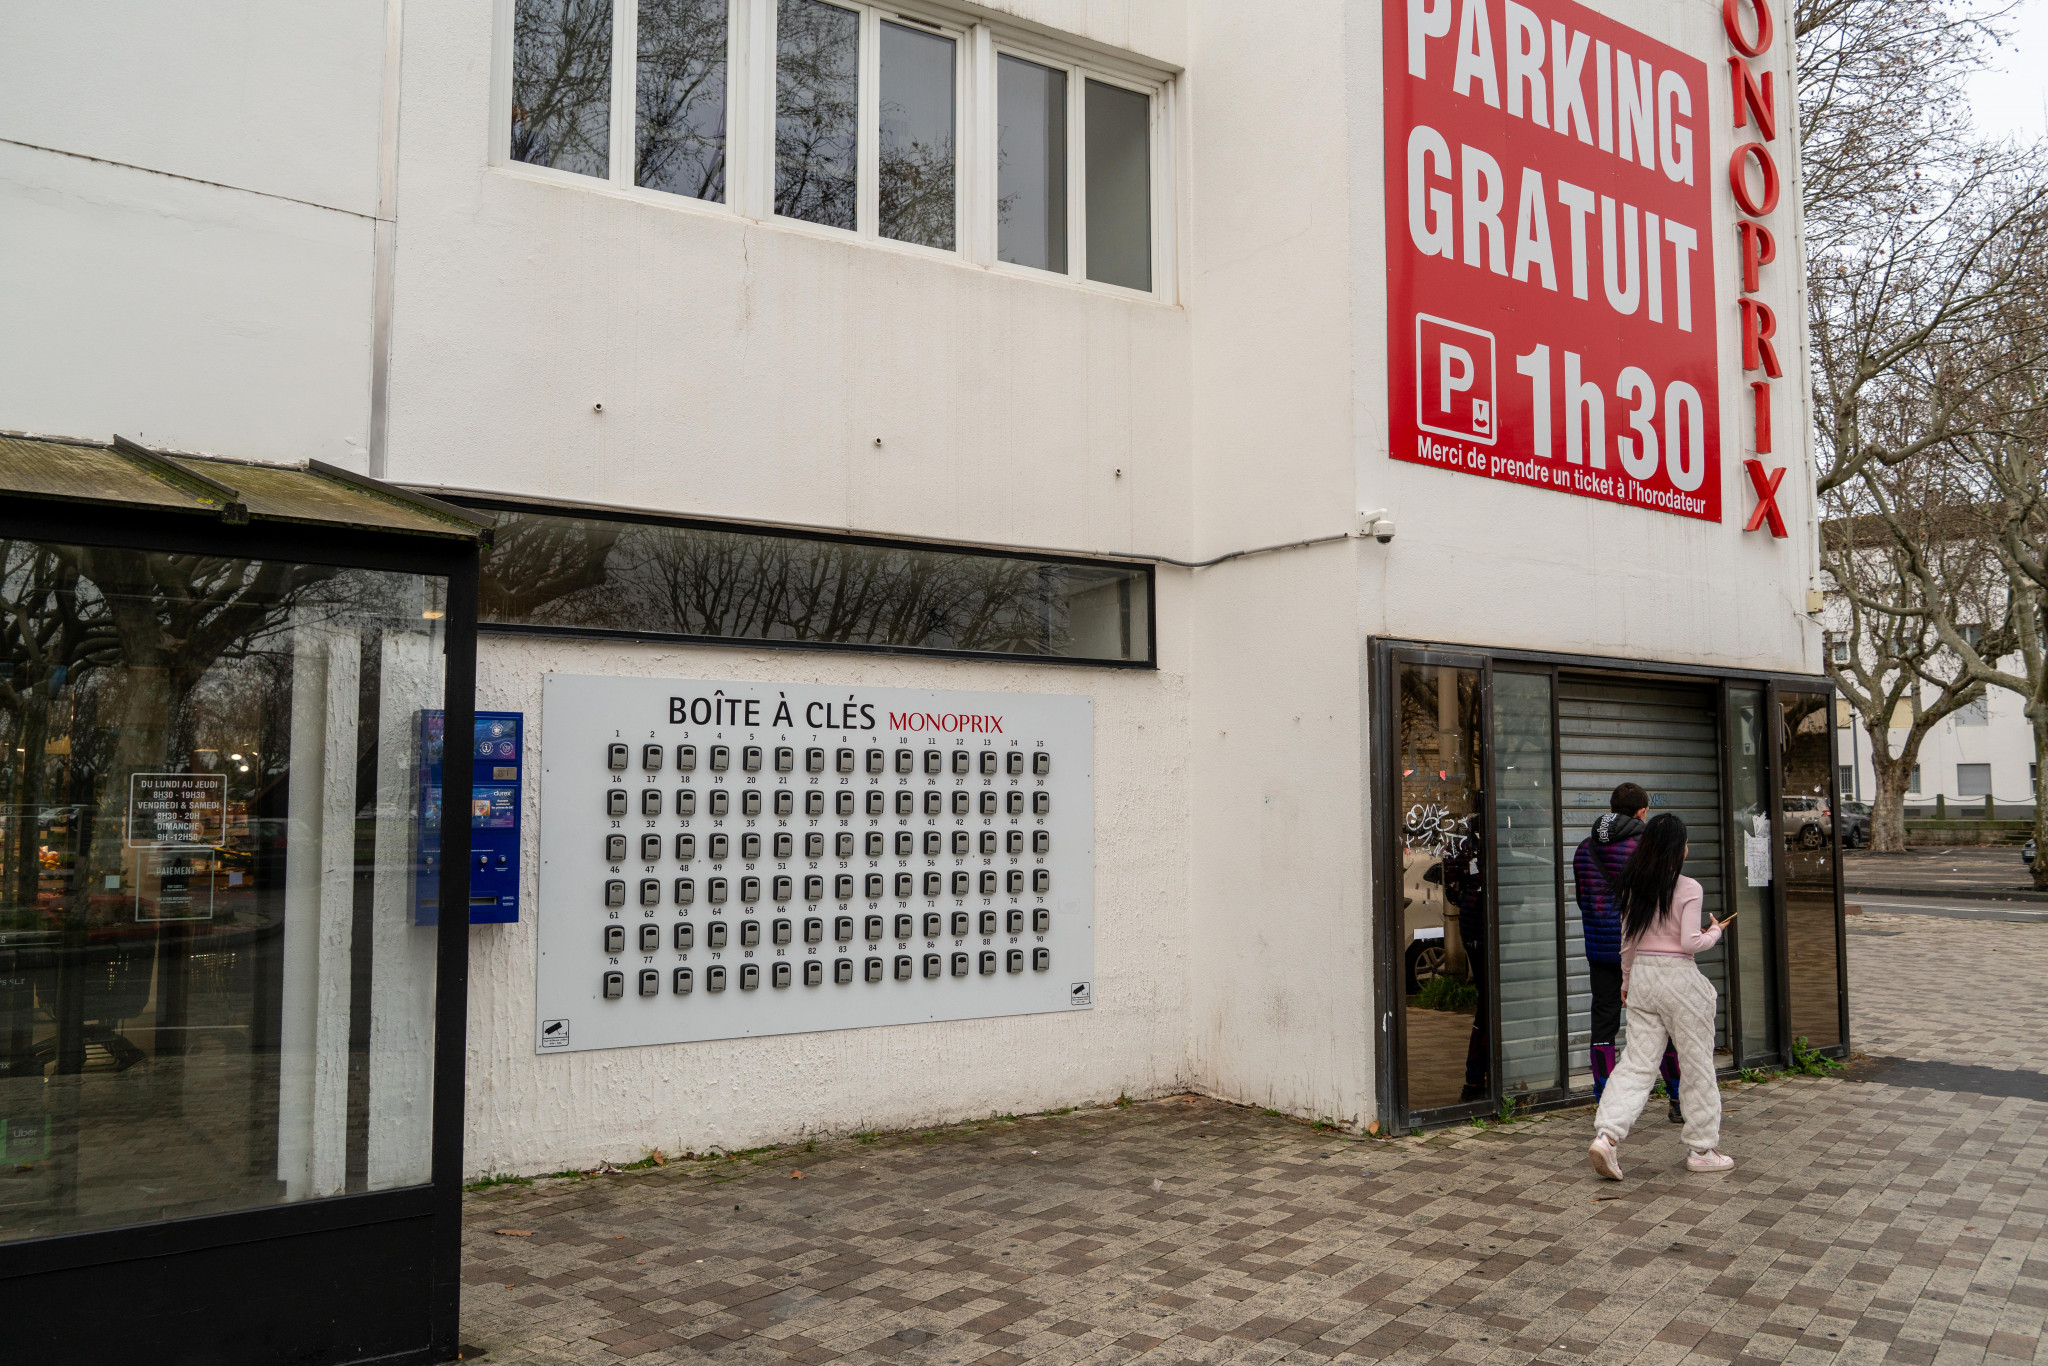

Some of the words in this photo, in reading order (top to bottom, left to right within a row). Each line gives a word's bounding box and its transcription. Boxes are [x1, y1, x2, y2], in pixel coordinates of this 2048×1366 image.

[1407, 0, 1694, 186] PARKING
[1407, 125, 1697, 332] GRATUIT
[1440, 342, 1475, 413] P
[1418, 435, 1462, 466] Merci
[1467, 446, 1486, 470] de
[1491, 455, 1549, 483] prendre
[1553, 468, 1570, 487] un
[1573, 469, 1614, 496] ticket
[1617, 477, 1625, 498] à
[1628, 480, 1706, 514] l'horodateur
[668, 690, 760, 725] BOÎTE
[772, 691, 794, 728] À
[806, 694, 876, 730] CLÉS
[889, 712, 1003, 734] MONOPRIX
[899, 736, 908, 744] 10
[928, 737, 936, 745] 11
[956, 738, 964, 746] 12
[983, 738, 992, 746] 13
[1010, 739, 1018, 747] 14
[1036, 740, 1044, 748] 15
[141, 780, 153, 788] DU
[155, 780, 180, 788] LUNDI
[182, 780, 193, 788] AU
[195, 780, 218, 788] JEUDI
[612, 775, 622, 783] 16
[646, 775, 657, 783] 17
[680, 775, 690, 784] 18
[714, 775, 724, 784] 19
[746, 776, 756, 784] 20
[778, 776, 787, 784] 21
[809, 777, 819, 785] 22
[840, 777, 849, 785] 23
[869, 777, 878, 785] 24
[899, 777, 908, 785] 25
[927, 778, 936, 786] 26
[955, 778, 964, 786] 27
[983, 778, 992, 786] 28
[1010, 778, 1018, 786] 29
[1036, 779, 1044, 787] 30
[153, 791, 174, 799] 8H30
[181, 791, 206, 799] 19H30
[138, 801, 179, 809] VENDREDI
[181, 801, 187, 809] &
[189, 801, 220, 809] SAMEDI
[157, 812, 178, 820] 8H30
[184, 812, 200, 820] 20H
[157, 823, 200, 831] DIMANCHE
[611, 820, 621, 828] 31
[646, 820, 656, 828] 32
[680, 819, 690, 828] 33
[713, 819, 723, 828] 34
[746, 819, 756, 828] 35
[778, 819, 787, 827] 36
[809, 819, 818, 827] 37
[839, 819, 849, 827] 38
[869, 818, 878, 827] 39
[898, 818, 908, 826] 40
[927, 818, 936, 826] 41
[955, 818, 964, 826] 42
[983, 818, 991, 826] 43
[1036, 818, 1044, 826] 45
[157, 833, 168, 841] 9H
[156, 866, 195, 875] PAIEMENT
[609, 865, 620, 874] 46
[645, 865, 655, 873] 47
[679, 864, 689, 872] 48
[712, 863, 723, 872] 49
[745, 862, 755, 871] 50
[777, 862, 787, 870] 51
[809, 861, 818, 870] 52
[839, 861, 848, 869] 53
[869, 860, 878, 868] 54
[898, 859, 907, 868] 55
[927, 859, 936, 867] 56
[955, 858, 964, 866] 57
[983, 858, 991, 866] 58
[1010, 857, 1018, 865] 59
[1036, 857, 1044, 865] 60
[609, 911, 619, 920] 61
[644, 910, 654, 918] 62
[678, 908, 688, 917] 63
[712, 907, 722, 916] 64
[744, 906, 754, 915] 65
[776, 905, 786, 913] 66
[808, 904, 817, 912] 67
[838, 903, 848, 911] 68
[868, 902, 878, 910] 69
[898, 901, 907, 909] 70
[982, 898, 991, 906] 73
[1036, 896, 1044, 904] 75
[608, 956, 619, 965] 76
[643, 955, 653, 964] 77
[678, 953, 688, 962] 78
[711, 951, 721, 960] 79
[744, 950, 754, 958] 80
[776, 948, 785, 957] 81
[807, 947, 817, 955] 82
[838, 945, 847, 953] 83
[868, 943, 877, 952] 84
[898, 942, 907, 950] 85
[926, 941, 935, 949] 86
[954, 939, 963, 947] 87
[982, 938, 991, 946] 88
[1009, 936, 1018, 944] 89
[1036, 935, 1044, 943] 90
[13, 1128, 38, 1138] Uber
